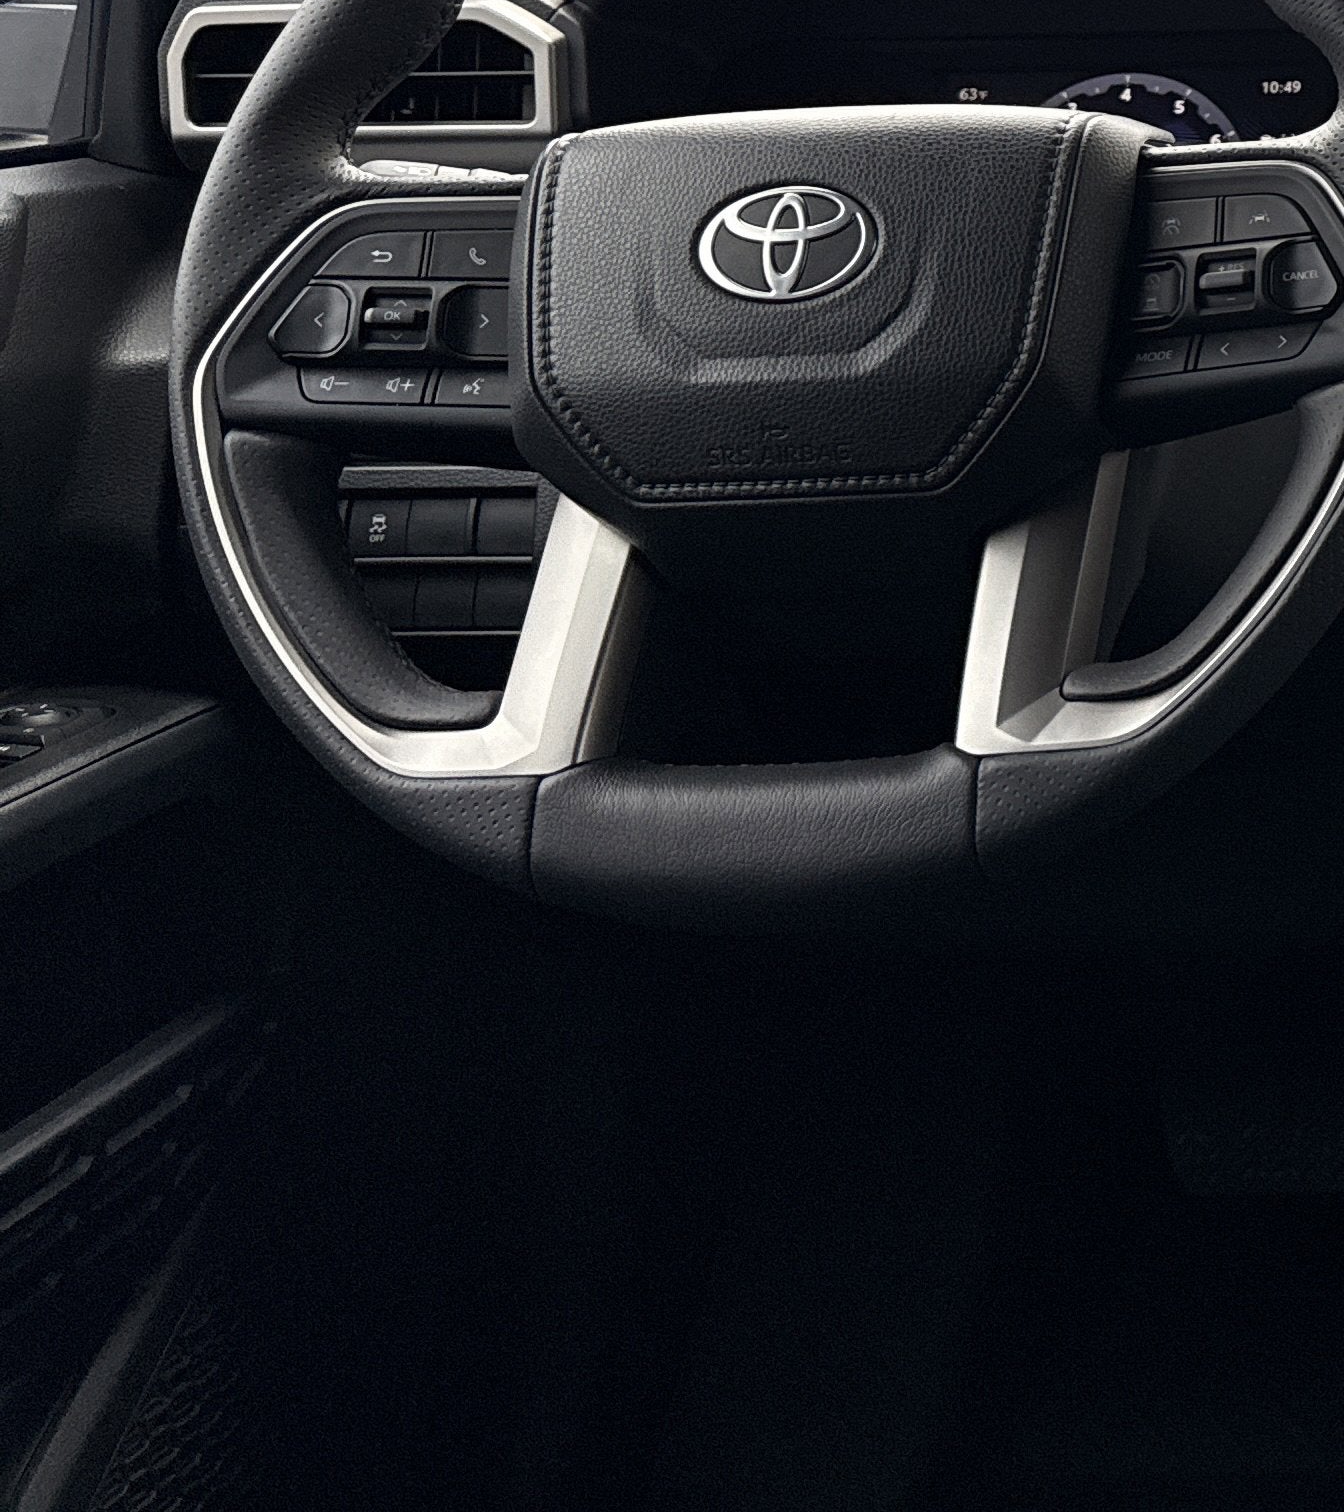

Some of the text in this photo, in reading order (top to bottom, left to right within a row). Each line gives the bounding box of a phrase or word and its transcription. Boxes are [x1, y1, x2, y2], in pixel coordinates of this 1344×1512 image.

[1119, 88, 1132, 102] 4
[1261, 81, 1302, 95] 10:49
[1173, 100, 1186, 115] 5
[1282, 270, 1320, 282] CANCEL
[383, 311, 401, 321] OK
[1134, 349, 1173, 363] MODE
[368, 534, 386, 544] OFF
